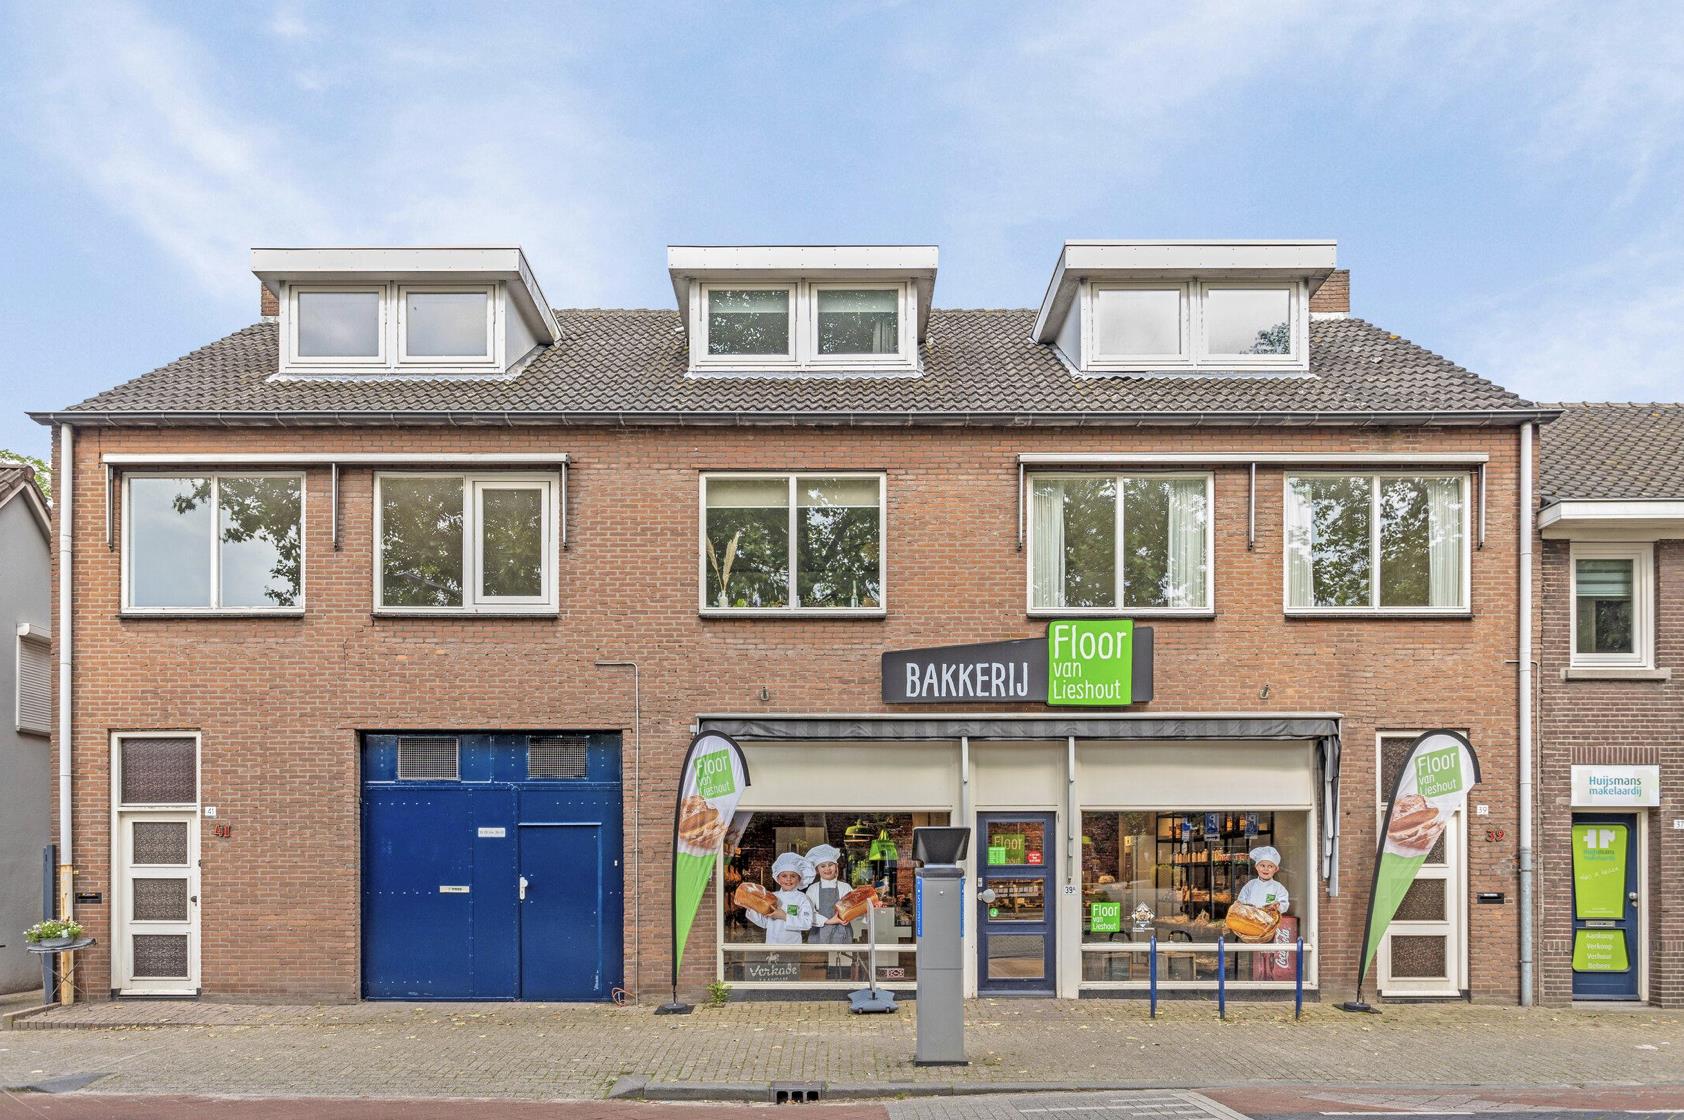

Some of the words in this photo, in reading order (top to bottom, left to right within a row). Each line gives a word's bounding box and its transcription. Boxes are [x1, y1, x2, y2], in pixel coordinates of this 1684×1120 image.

[1054, 625, 1127, 660] Floor
[1053, 662, 1082, 678] van
[906, 662, 1028, 698] BAKKERIJ
[1053, 679, 1121, 699] Lieshout
[697, 756, 728, 776] Floor
[1417, 753, 1457, 776] Floor
[1419, 774, 1435, 785] van
[1589, 776, 1642, 788] Huijsmans
[1589, 786, 1642, 797] makelaardij
[212, 824, 231, 838] 41
[1486, 830, 1504, 842] 39
[994, 835, 1022, 850] Floor
[1093, 904, 1117, 917] Floor
[1093, 922, 1117, 930] Lieshout
[750, 963, 797, 977] Verkade
